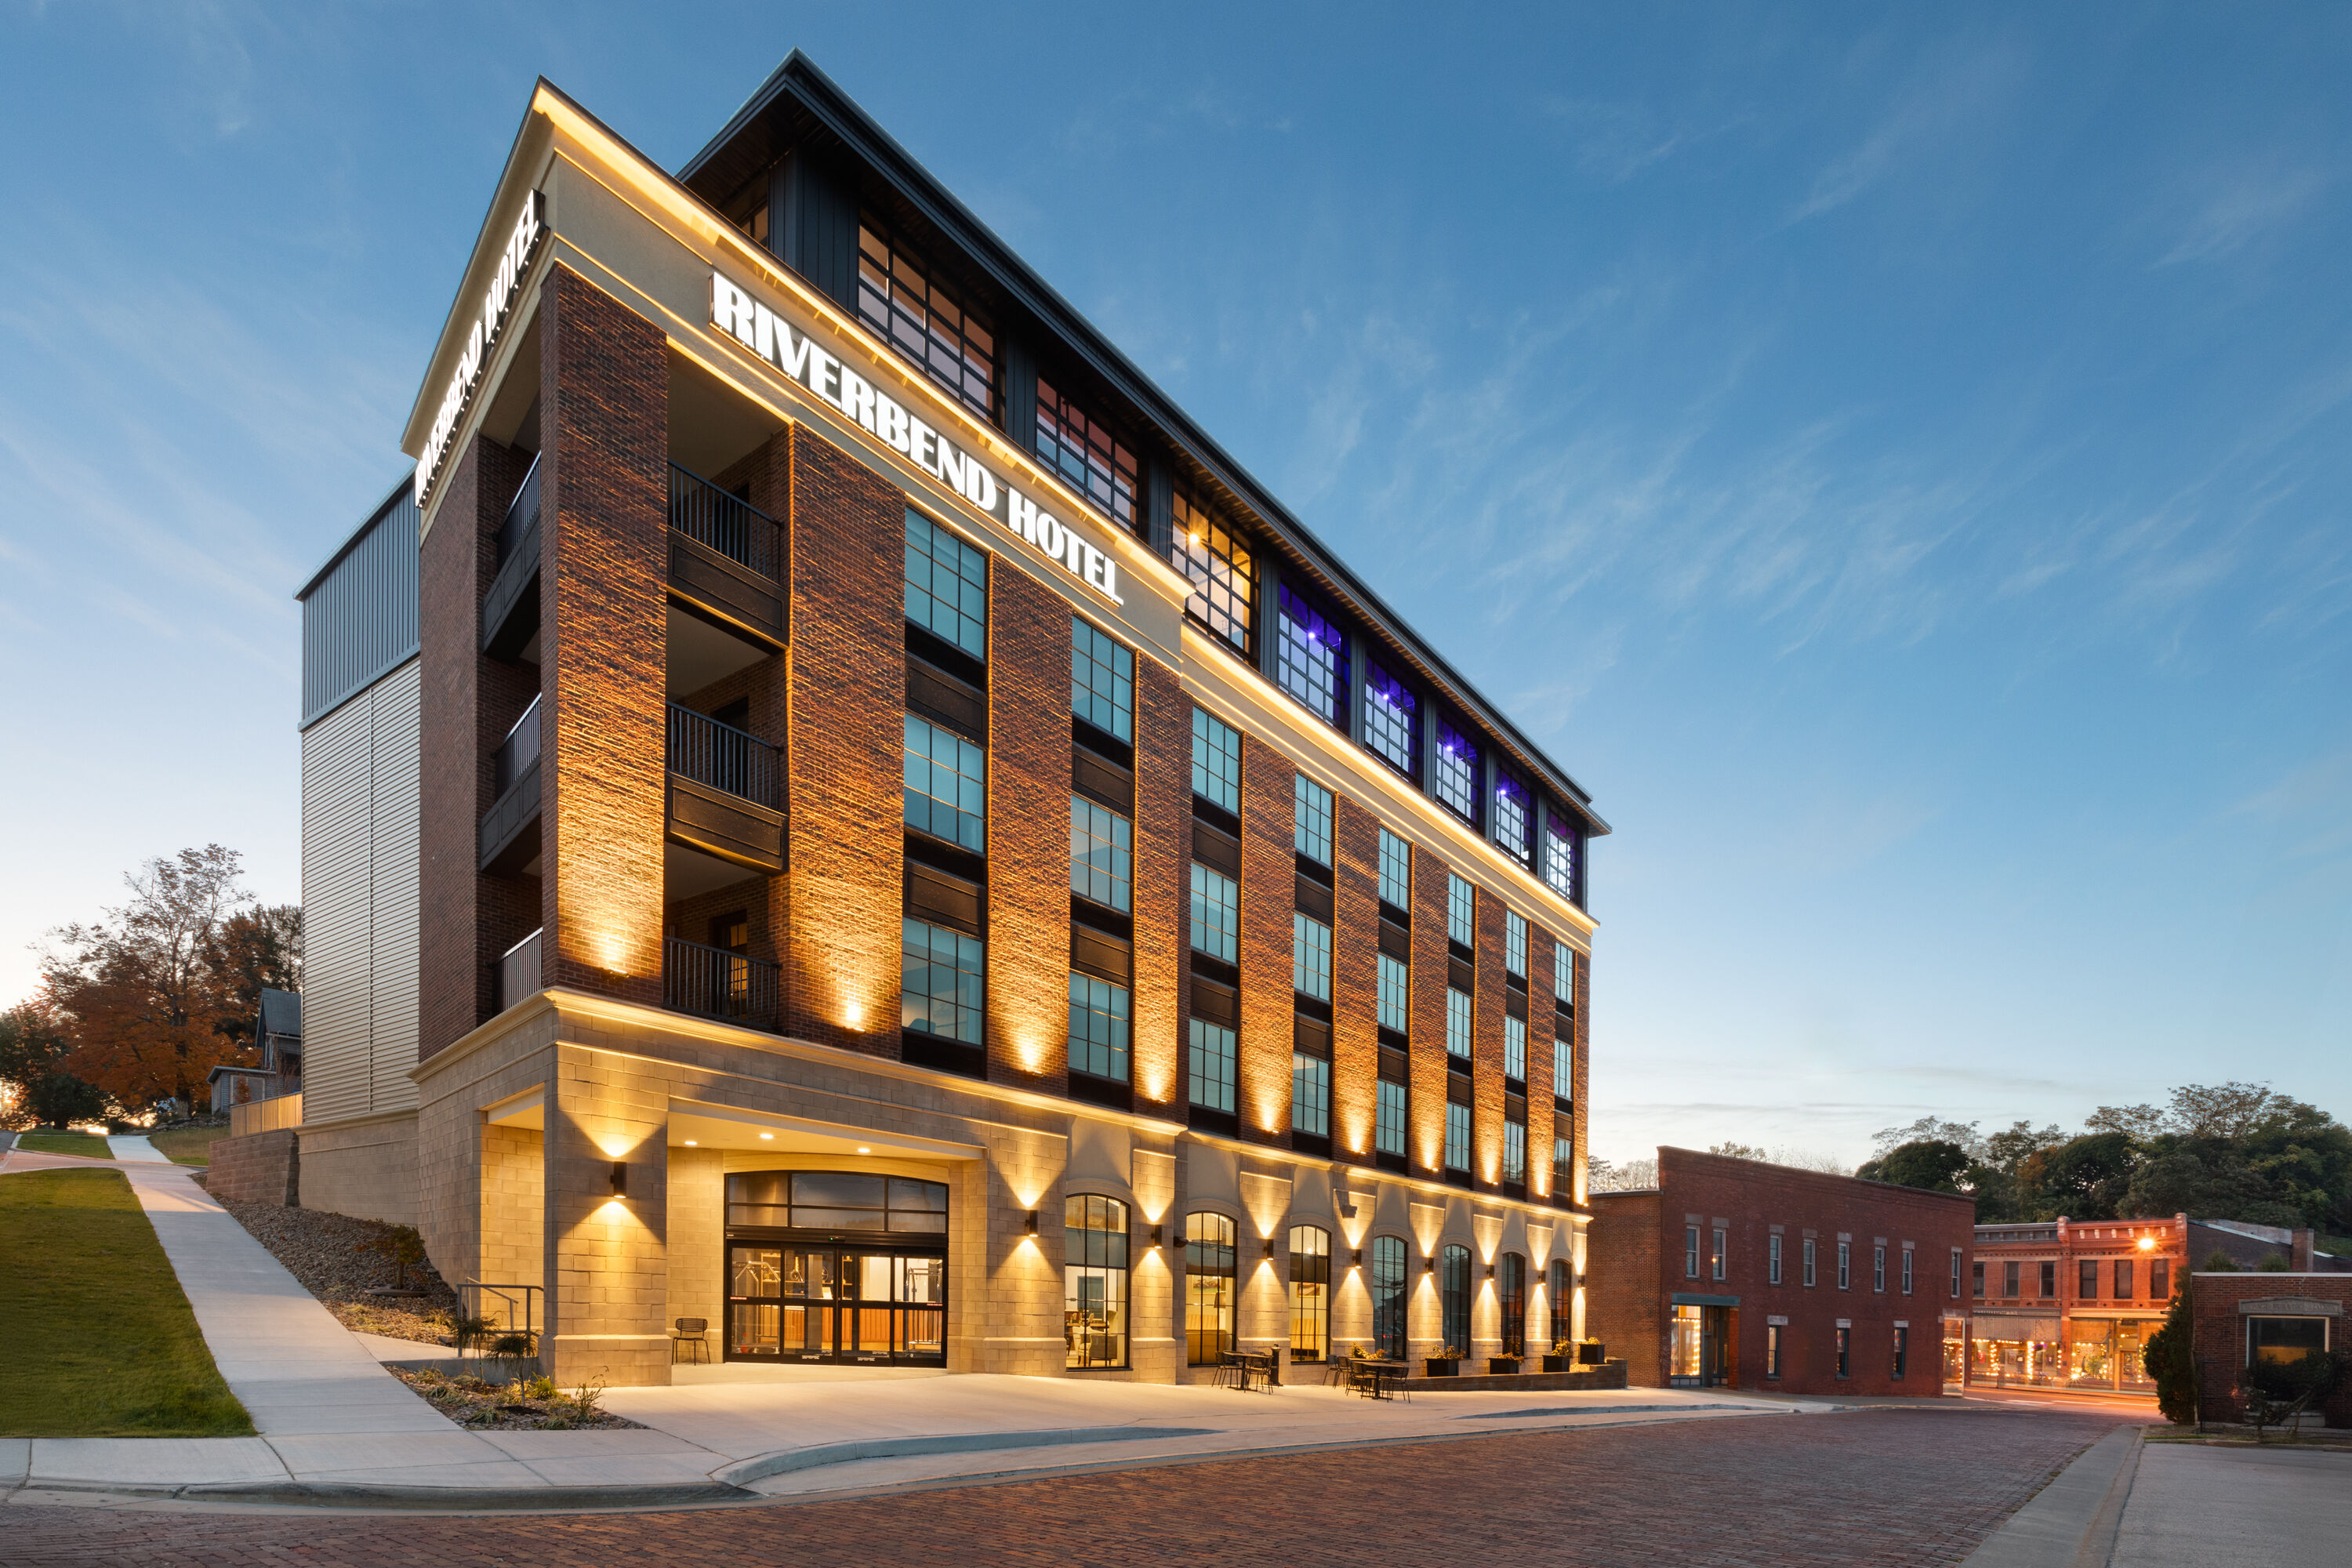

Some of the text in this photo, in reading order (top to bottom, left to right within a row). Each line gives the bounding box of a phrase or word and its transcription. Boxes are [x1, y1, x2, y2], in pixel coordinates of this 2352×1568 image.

[415, 189, 539, 506] RIVERBEND HOTEL
[713, 270, 1124, 606] RIVERBEND HOTEL
